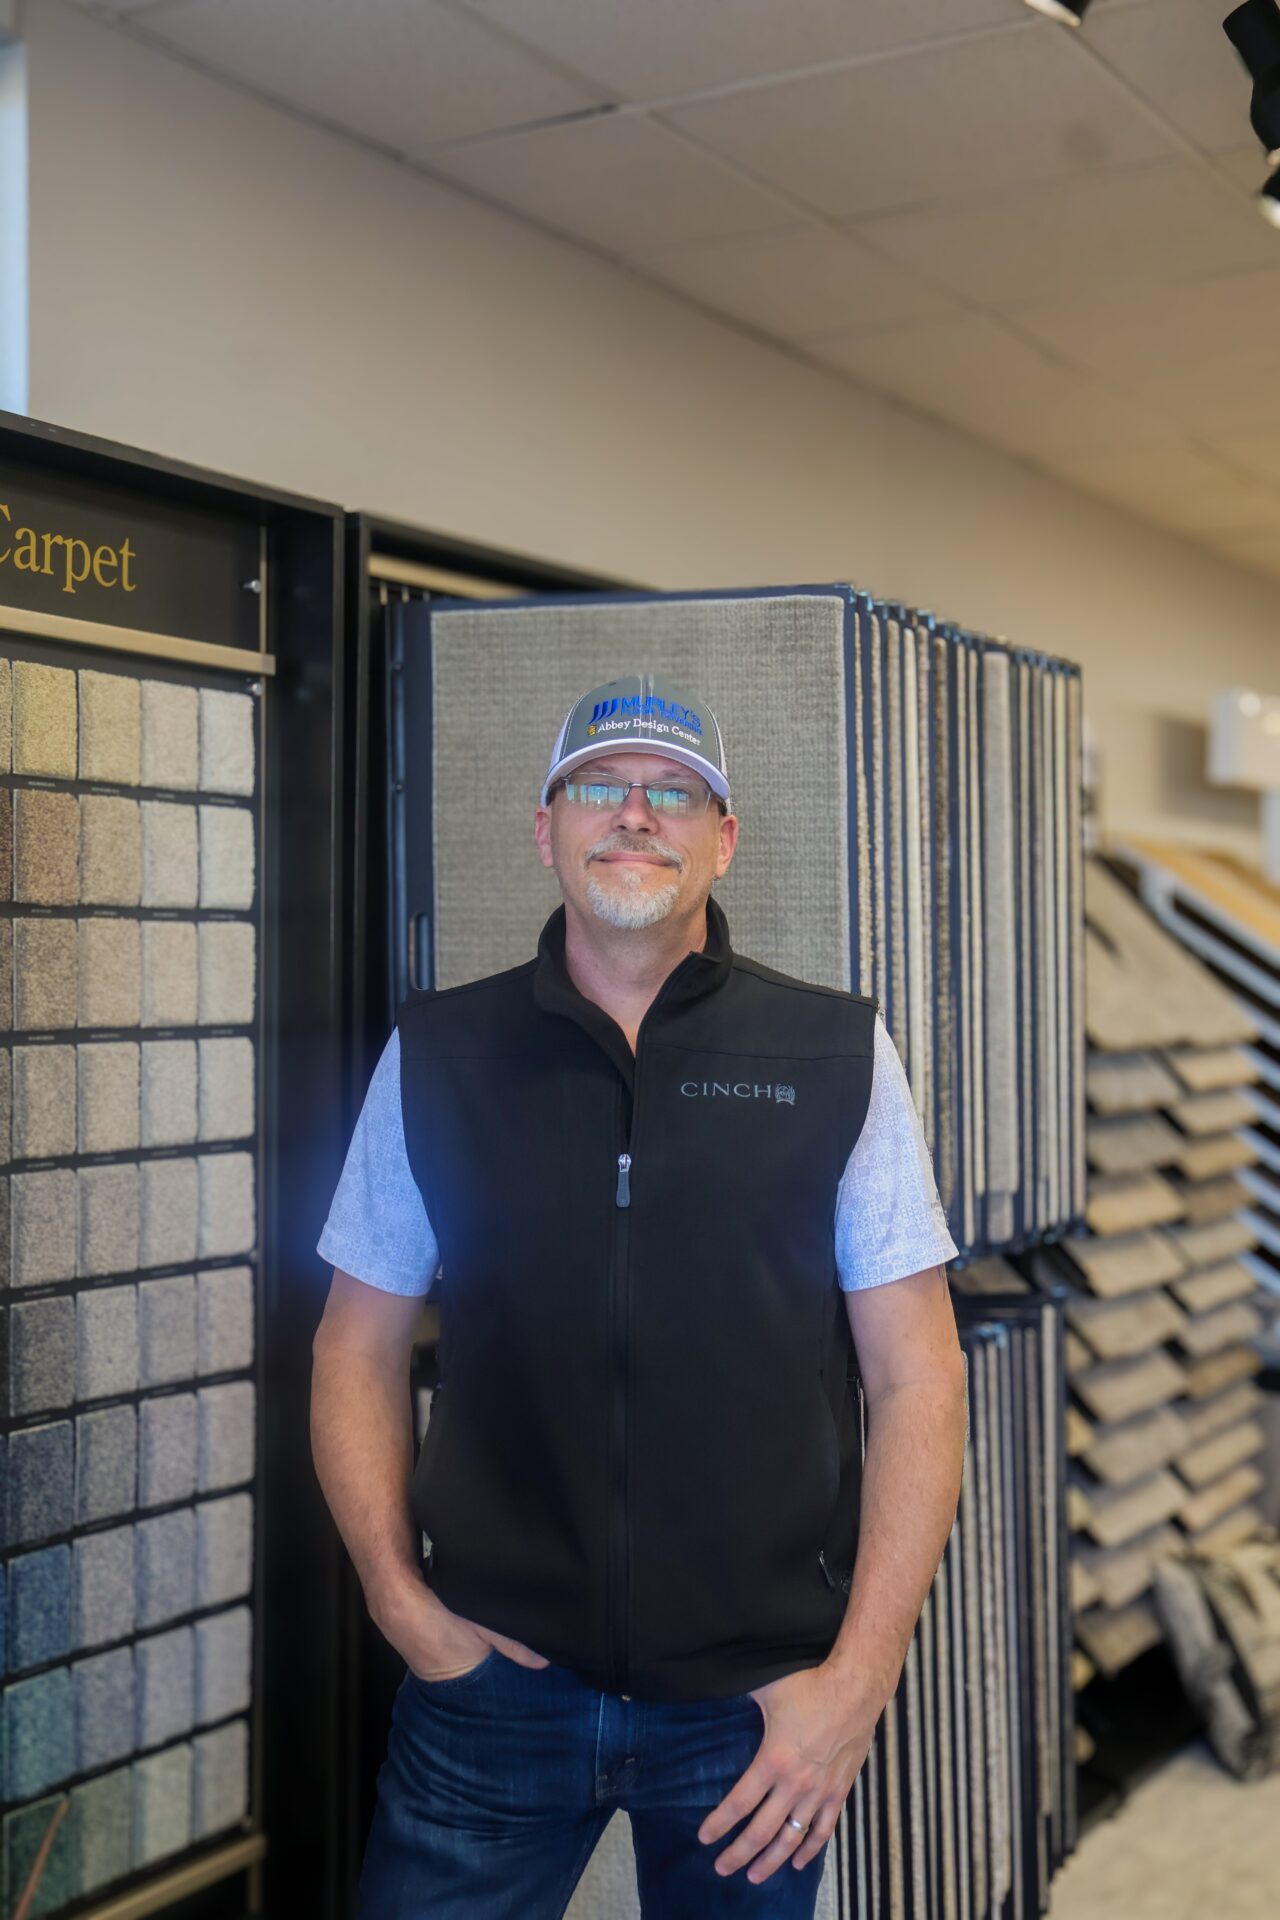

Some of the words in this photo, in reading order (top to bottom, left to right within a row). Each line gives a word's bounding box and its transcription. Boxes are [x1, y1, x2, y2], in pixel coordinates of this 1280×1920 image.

[597, 720, 631, 733] Abbey
[633, 718, 669, 733] Design
[671, 725, 701, 746] Center
[680, 1082, 771, 1098] CINCH
